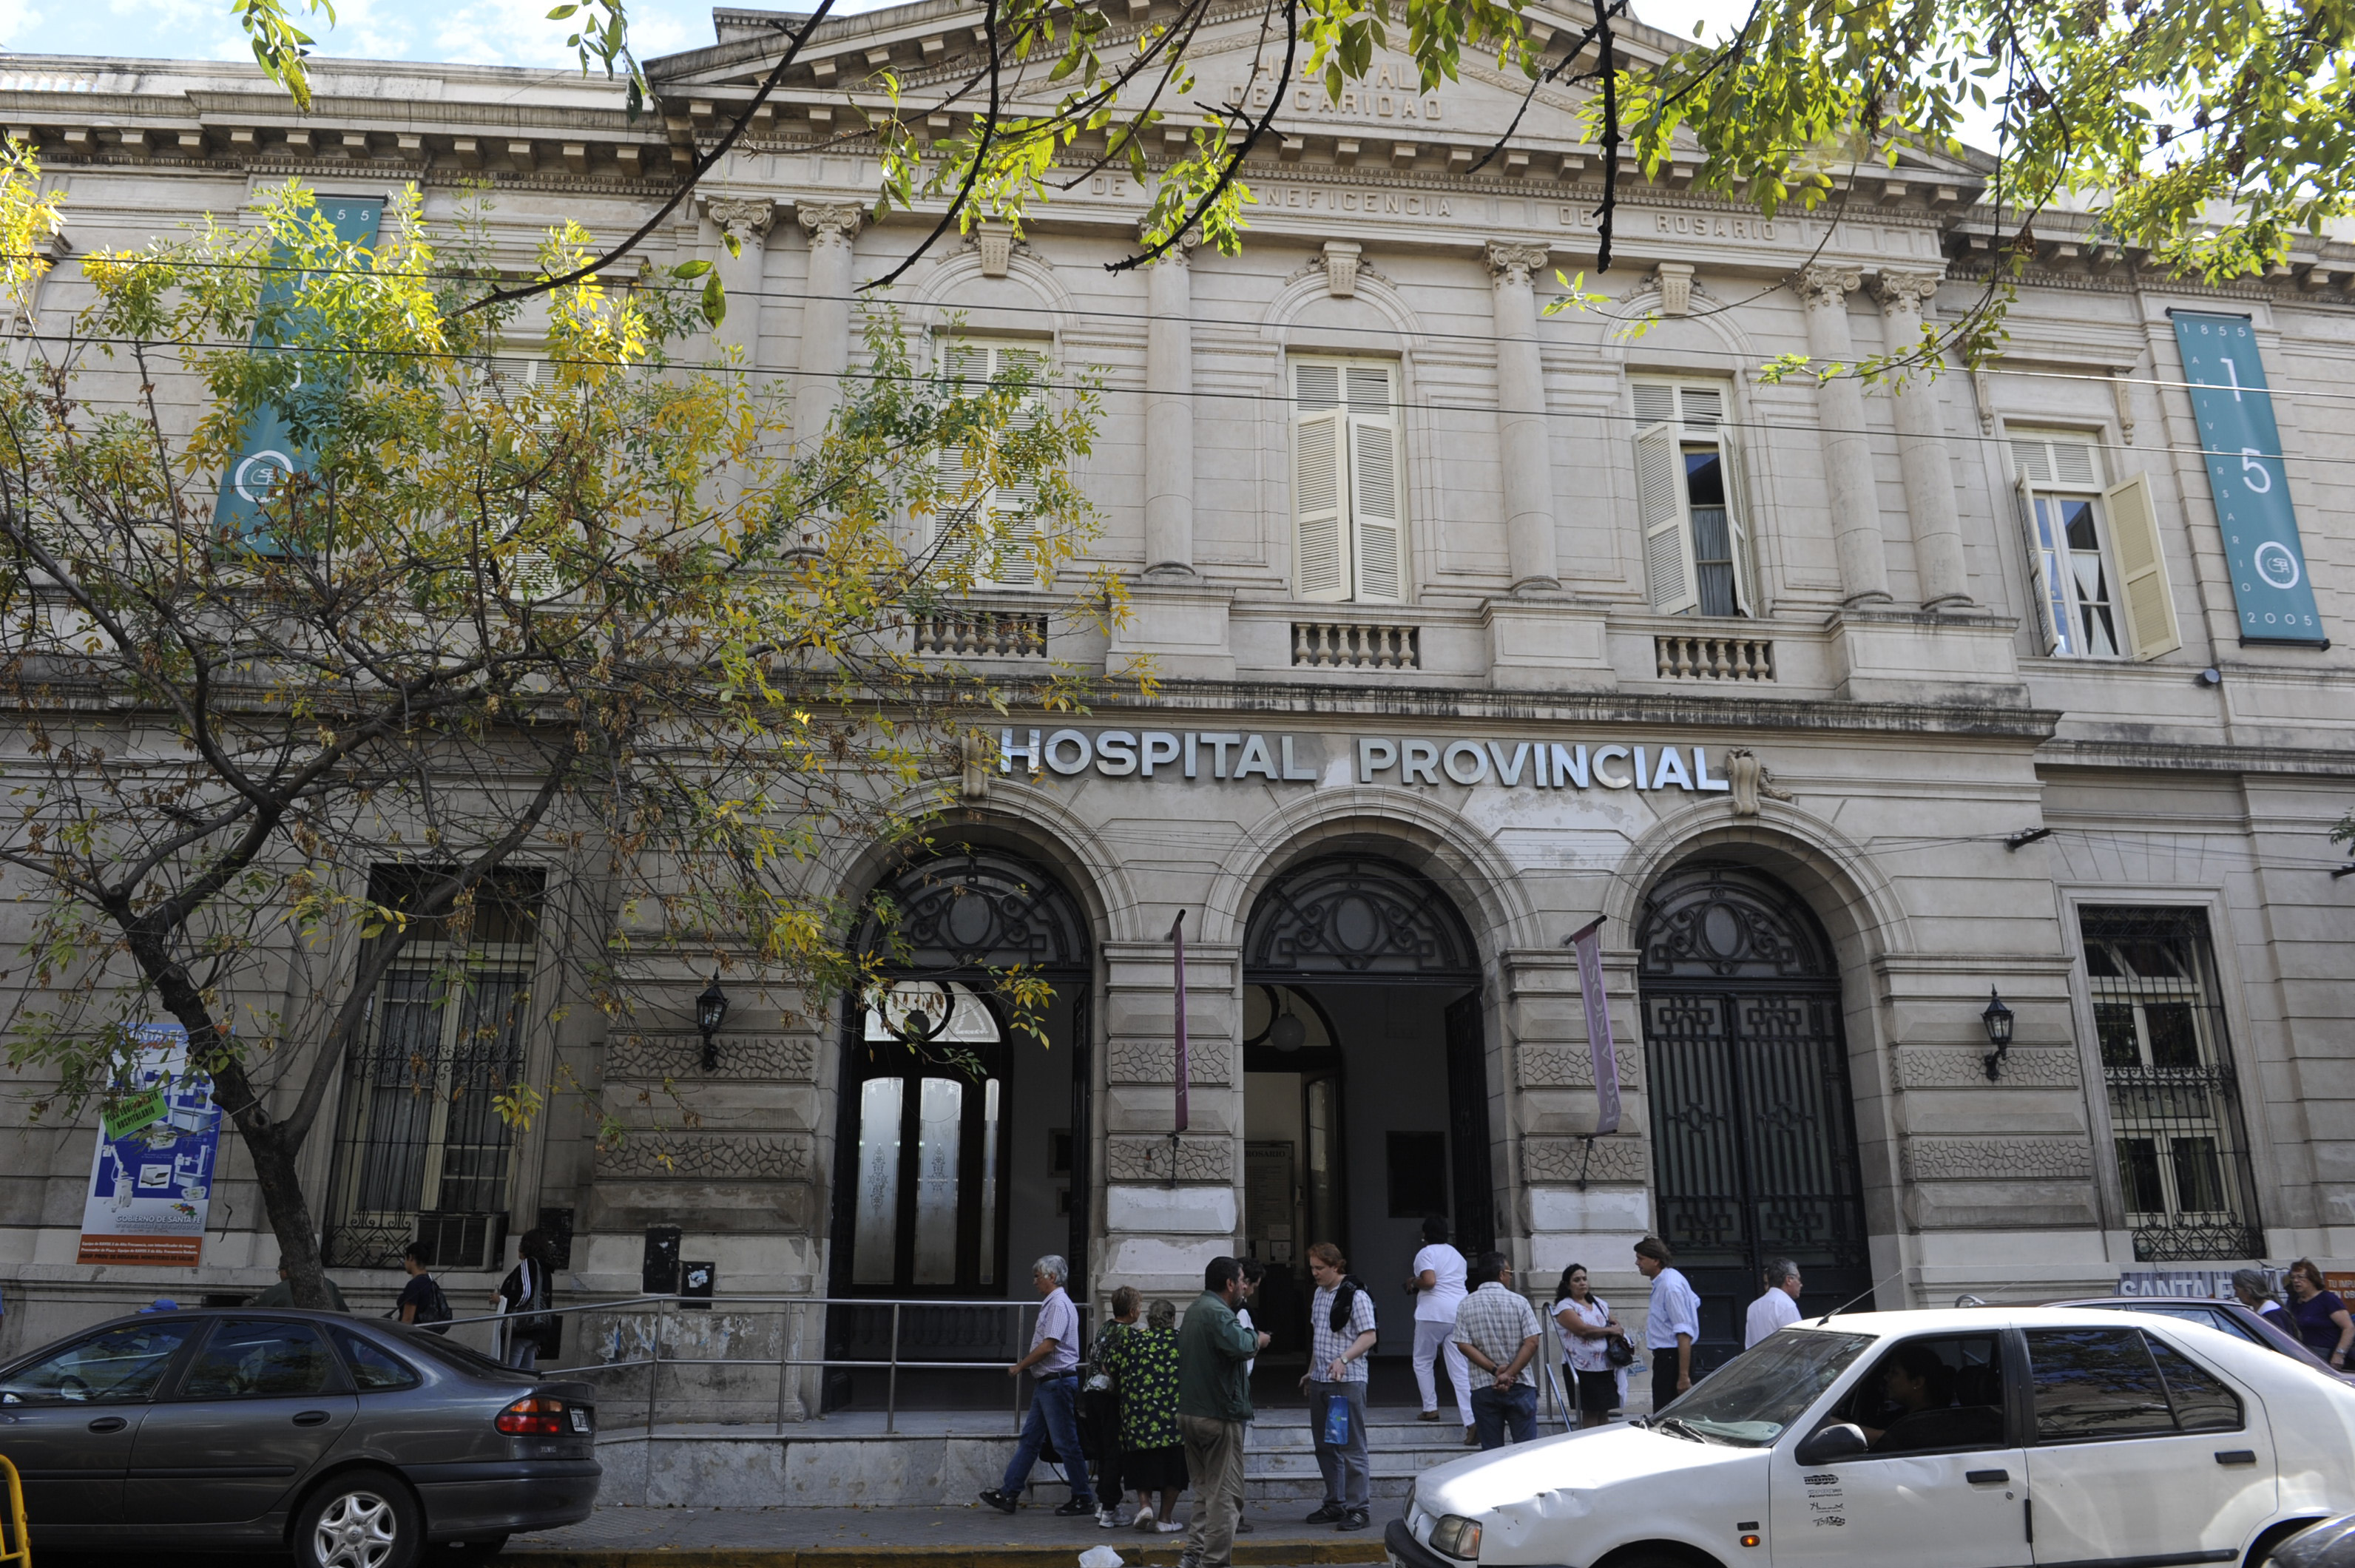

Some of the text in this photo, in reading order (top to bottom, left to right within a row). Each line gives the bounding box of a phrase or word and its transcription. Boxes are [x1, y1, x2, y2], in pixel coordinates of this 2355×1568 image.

[1229, 84, 1442, 119] DE CARIDAD
[1091, 176, 1126, 197] DE
[1656, 213, 1776, 240] ROSARIO
[2183, 323, 2246, 337] 1855
[2192, 356, 2251, 592] ANIVERSARIO
[2246, 612, 2313, 626] 2005
[999, 727, 1730, 791] HOSPITAL PROVINCIAL
[116, 1106, 155, 1129] HOSPITALARIO
[115, 1214, 201, 1225] GOBIERNO DE SANTA FE
[2121, 1280, 2208, 1297] SANTA
[2328, 1279, 2337, 1288] TU
